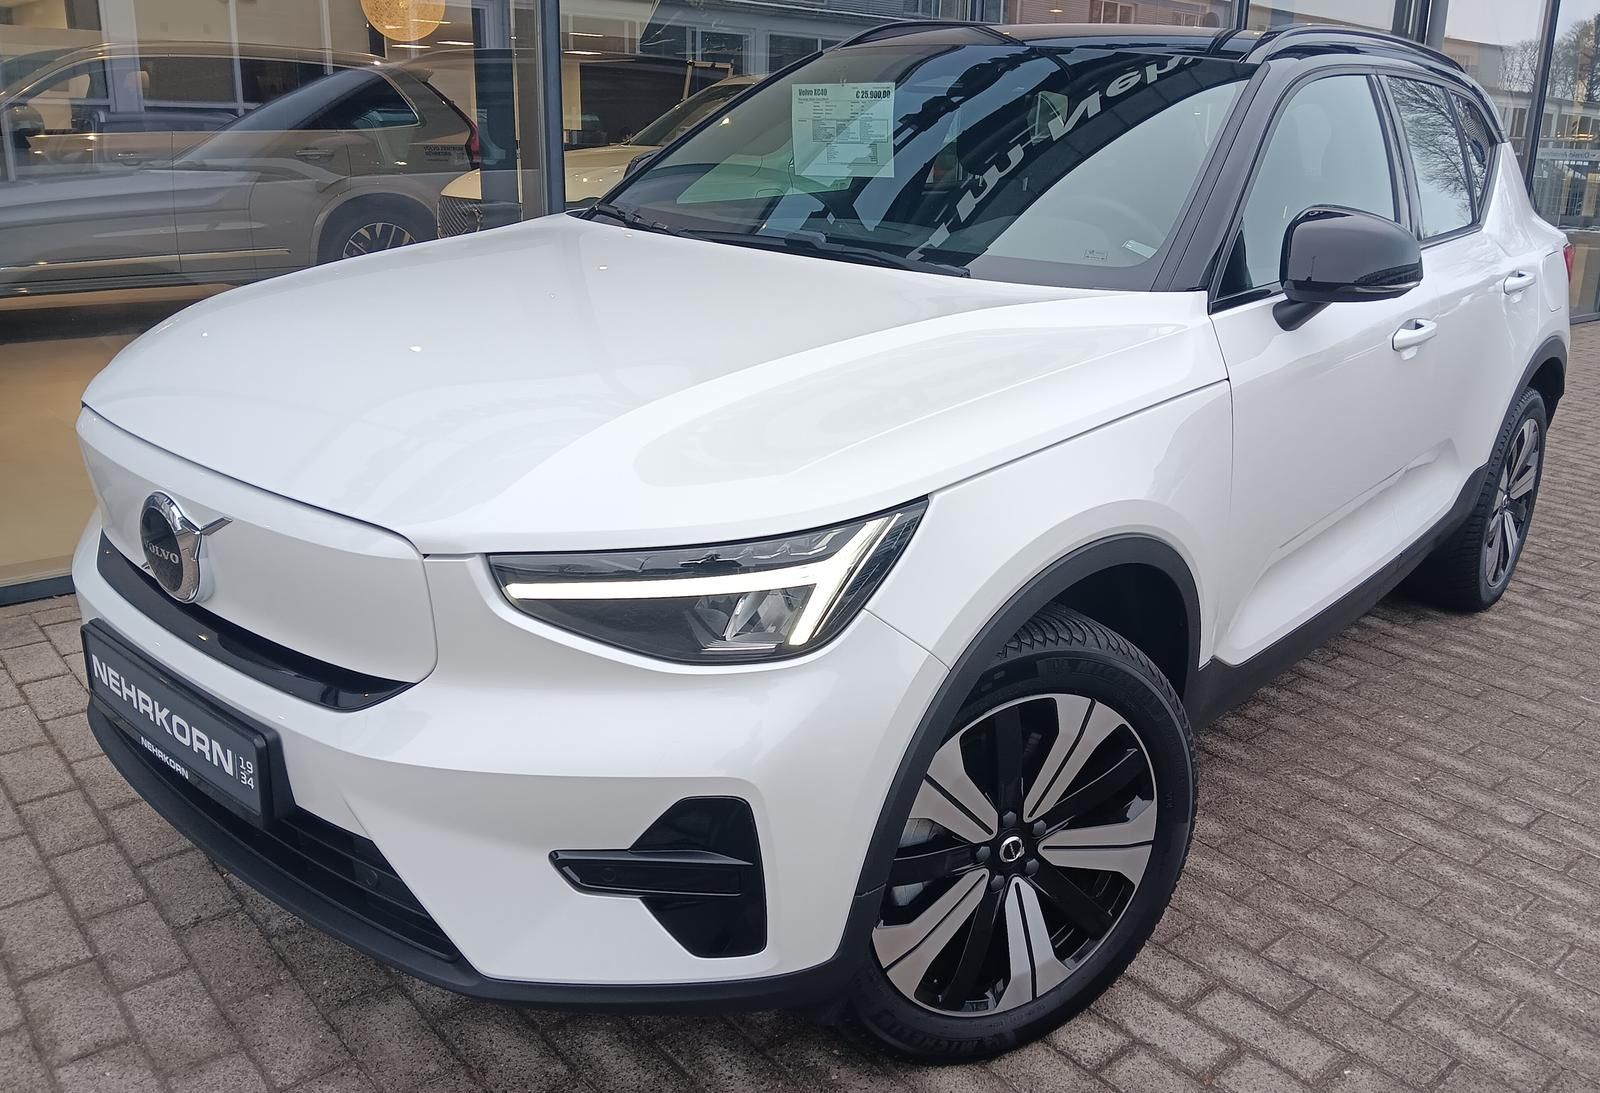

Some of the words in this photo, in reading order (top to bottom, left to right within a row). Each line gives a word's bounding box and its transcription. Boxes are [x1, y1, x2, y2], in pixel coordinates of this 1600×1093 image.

[798, 88, 813, 97] Volvo
[813, 88, 828, 97] XC40
[143, 540, 180, 565] VOLVO
[91, 653, 235, 777] NEHRKORN
[140, 735, 190, 780] NEHRKORN
[239, 756, 253, 774] 19
[240, 771, 255, 789] 34
